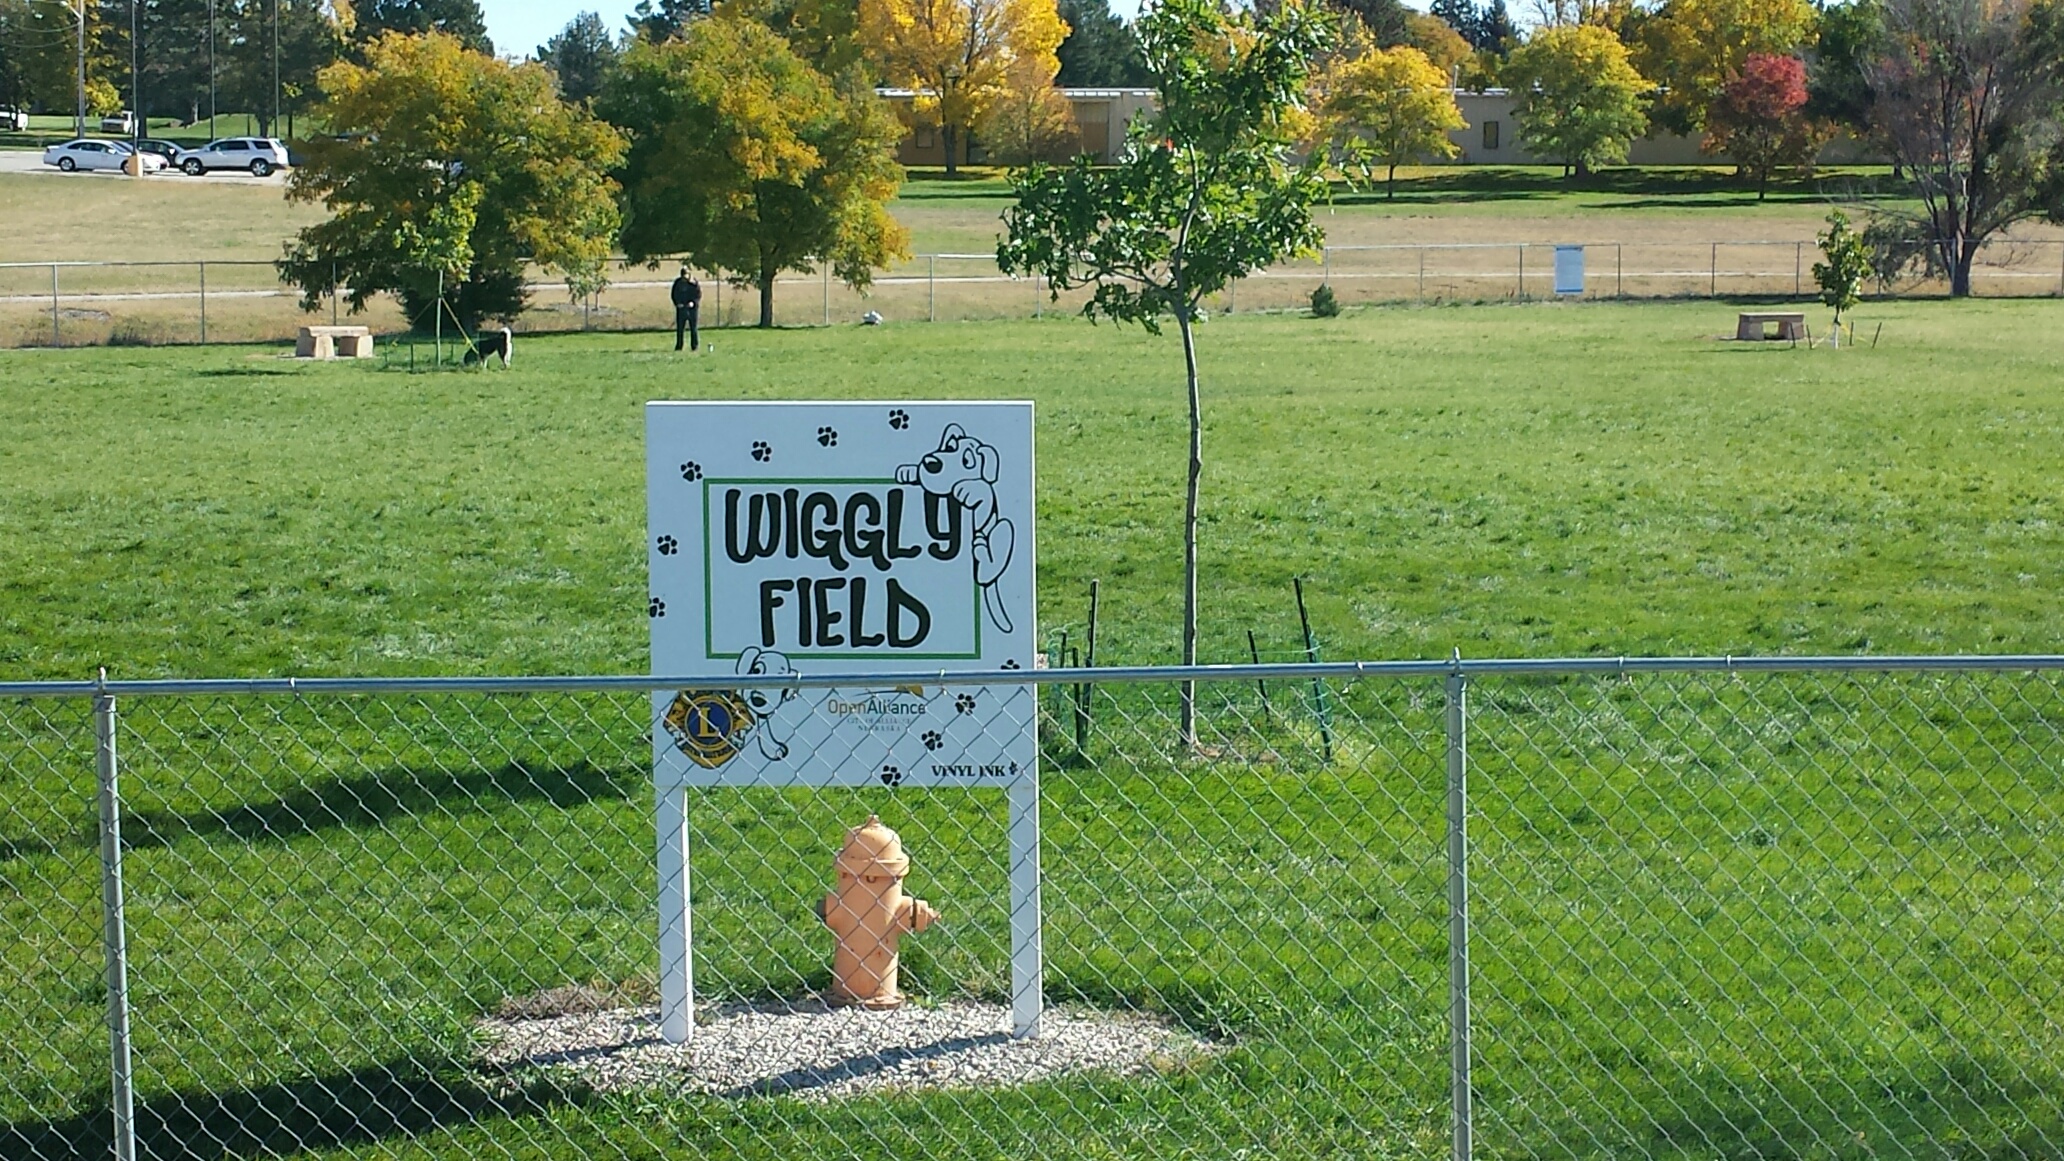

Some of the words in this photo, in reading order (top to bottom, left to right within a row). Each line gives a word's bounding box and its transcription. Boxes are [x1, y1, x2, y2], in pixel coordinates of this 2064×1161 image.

[725, 489, 962, 571] WIGGLY
[760, 578, 931, 648] FIELD
[931, 765, 976, 777] VINYL
[979, 765, 1006, 777] INK
